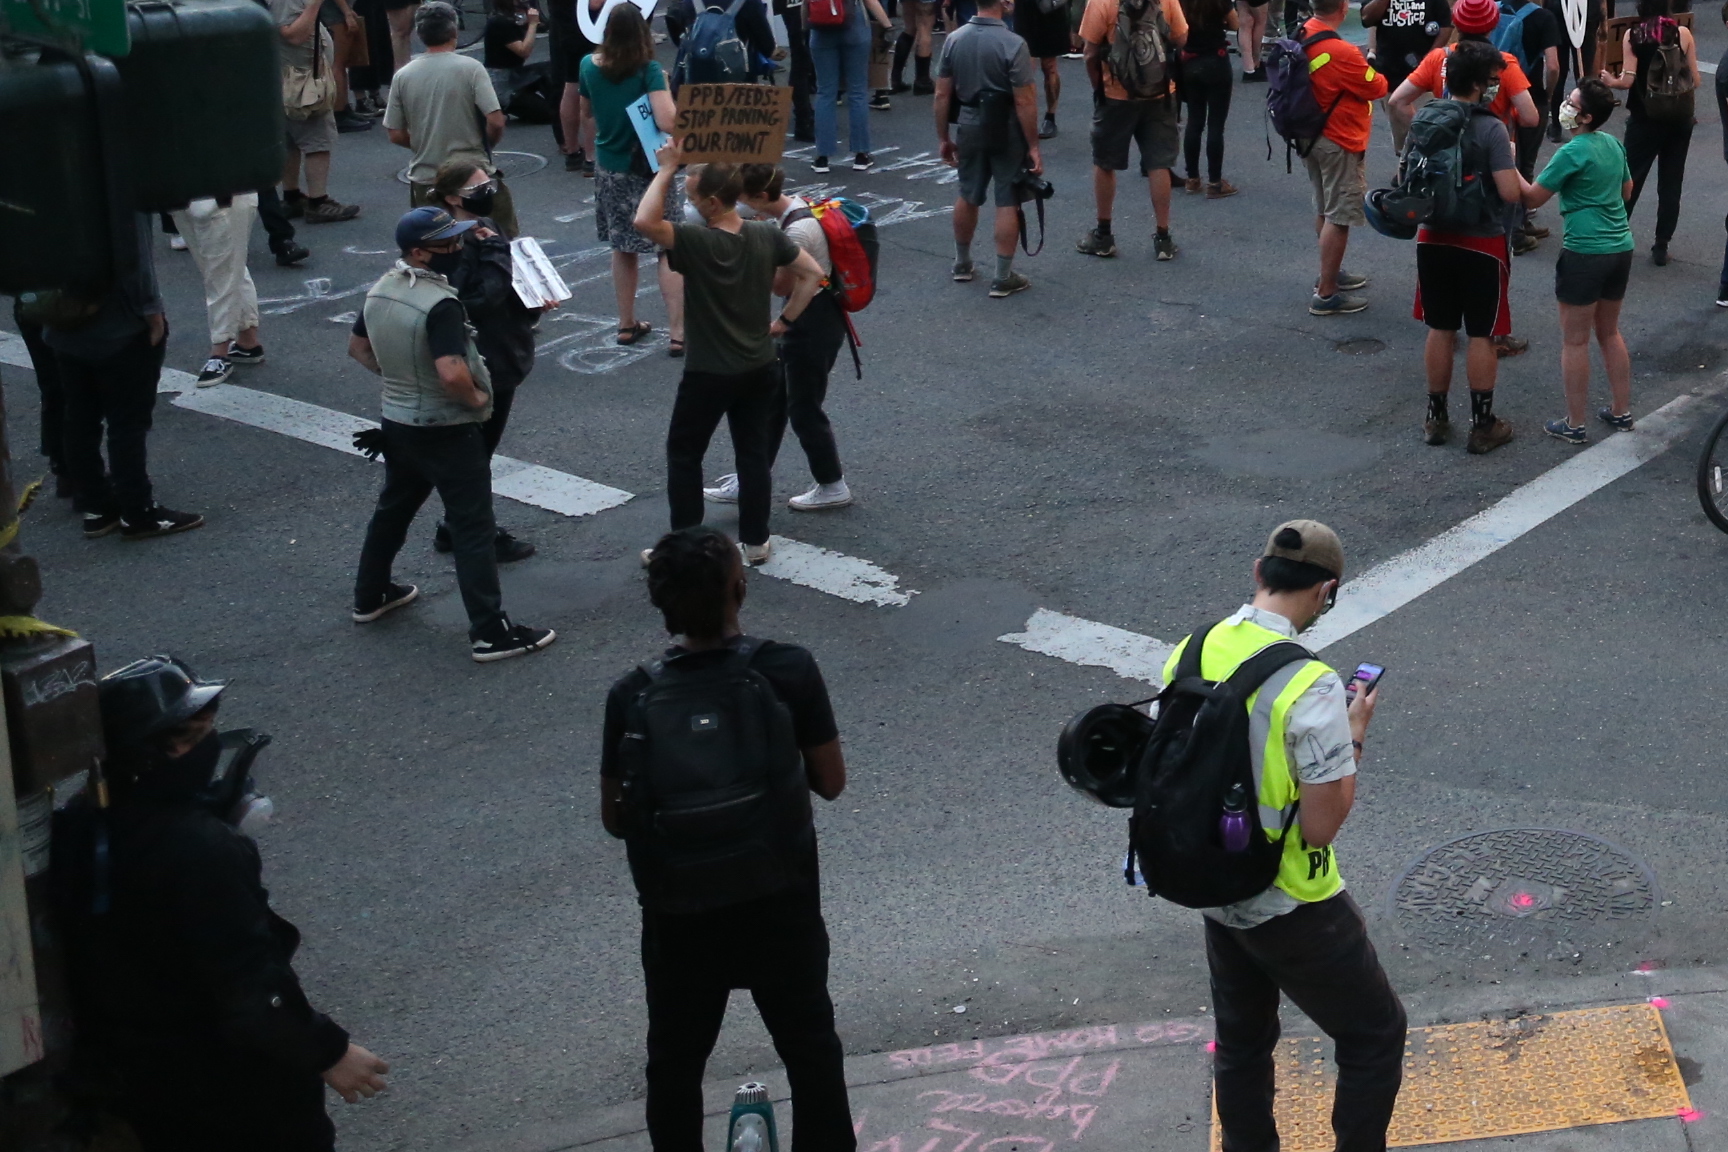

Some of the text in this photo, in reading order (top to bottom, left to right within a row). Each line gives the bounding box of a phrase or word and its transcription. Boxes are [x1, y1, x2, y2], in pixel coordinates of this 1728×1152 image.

[678, 107, 781, 130] STOP PROVING
[683, 131, 771, 155] OUR POINT
